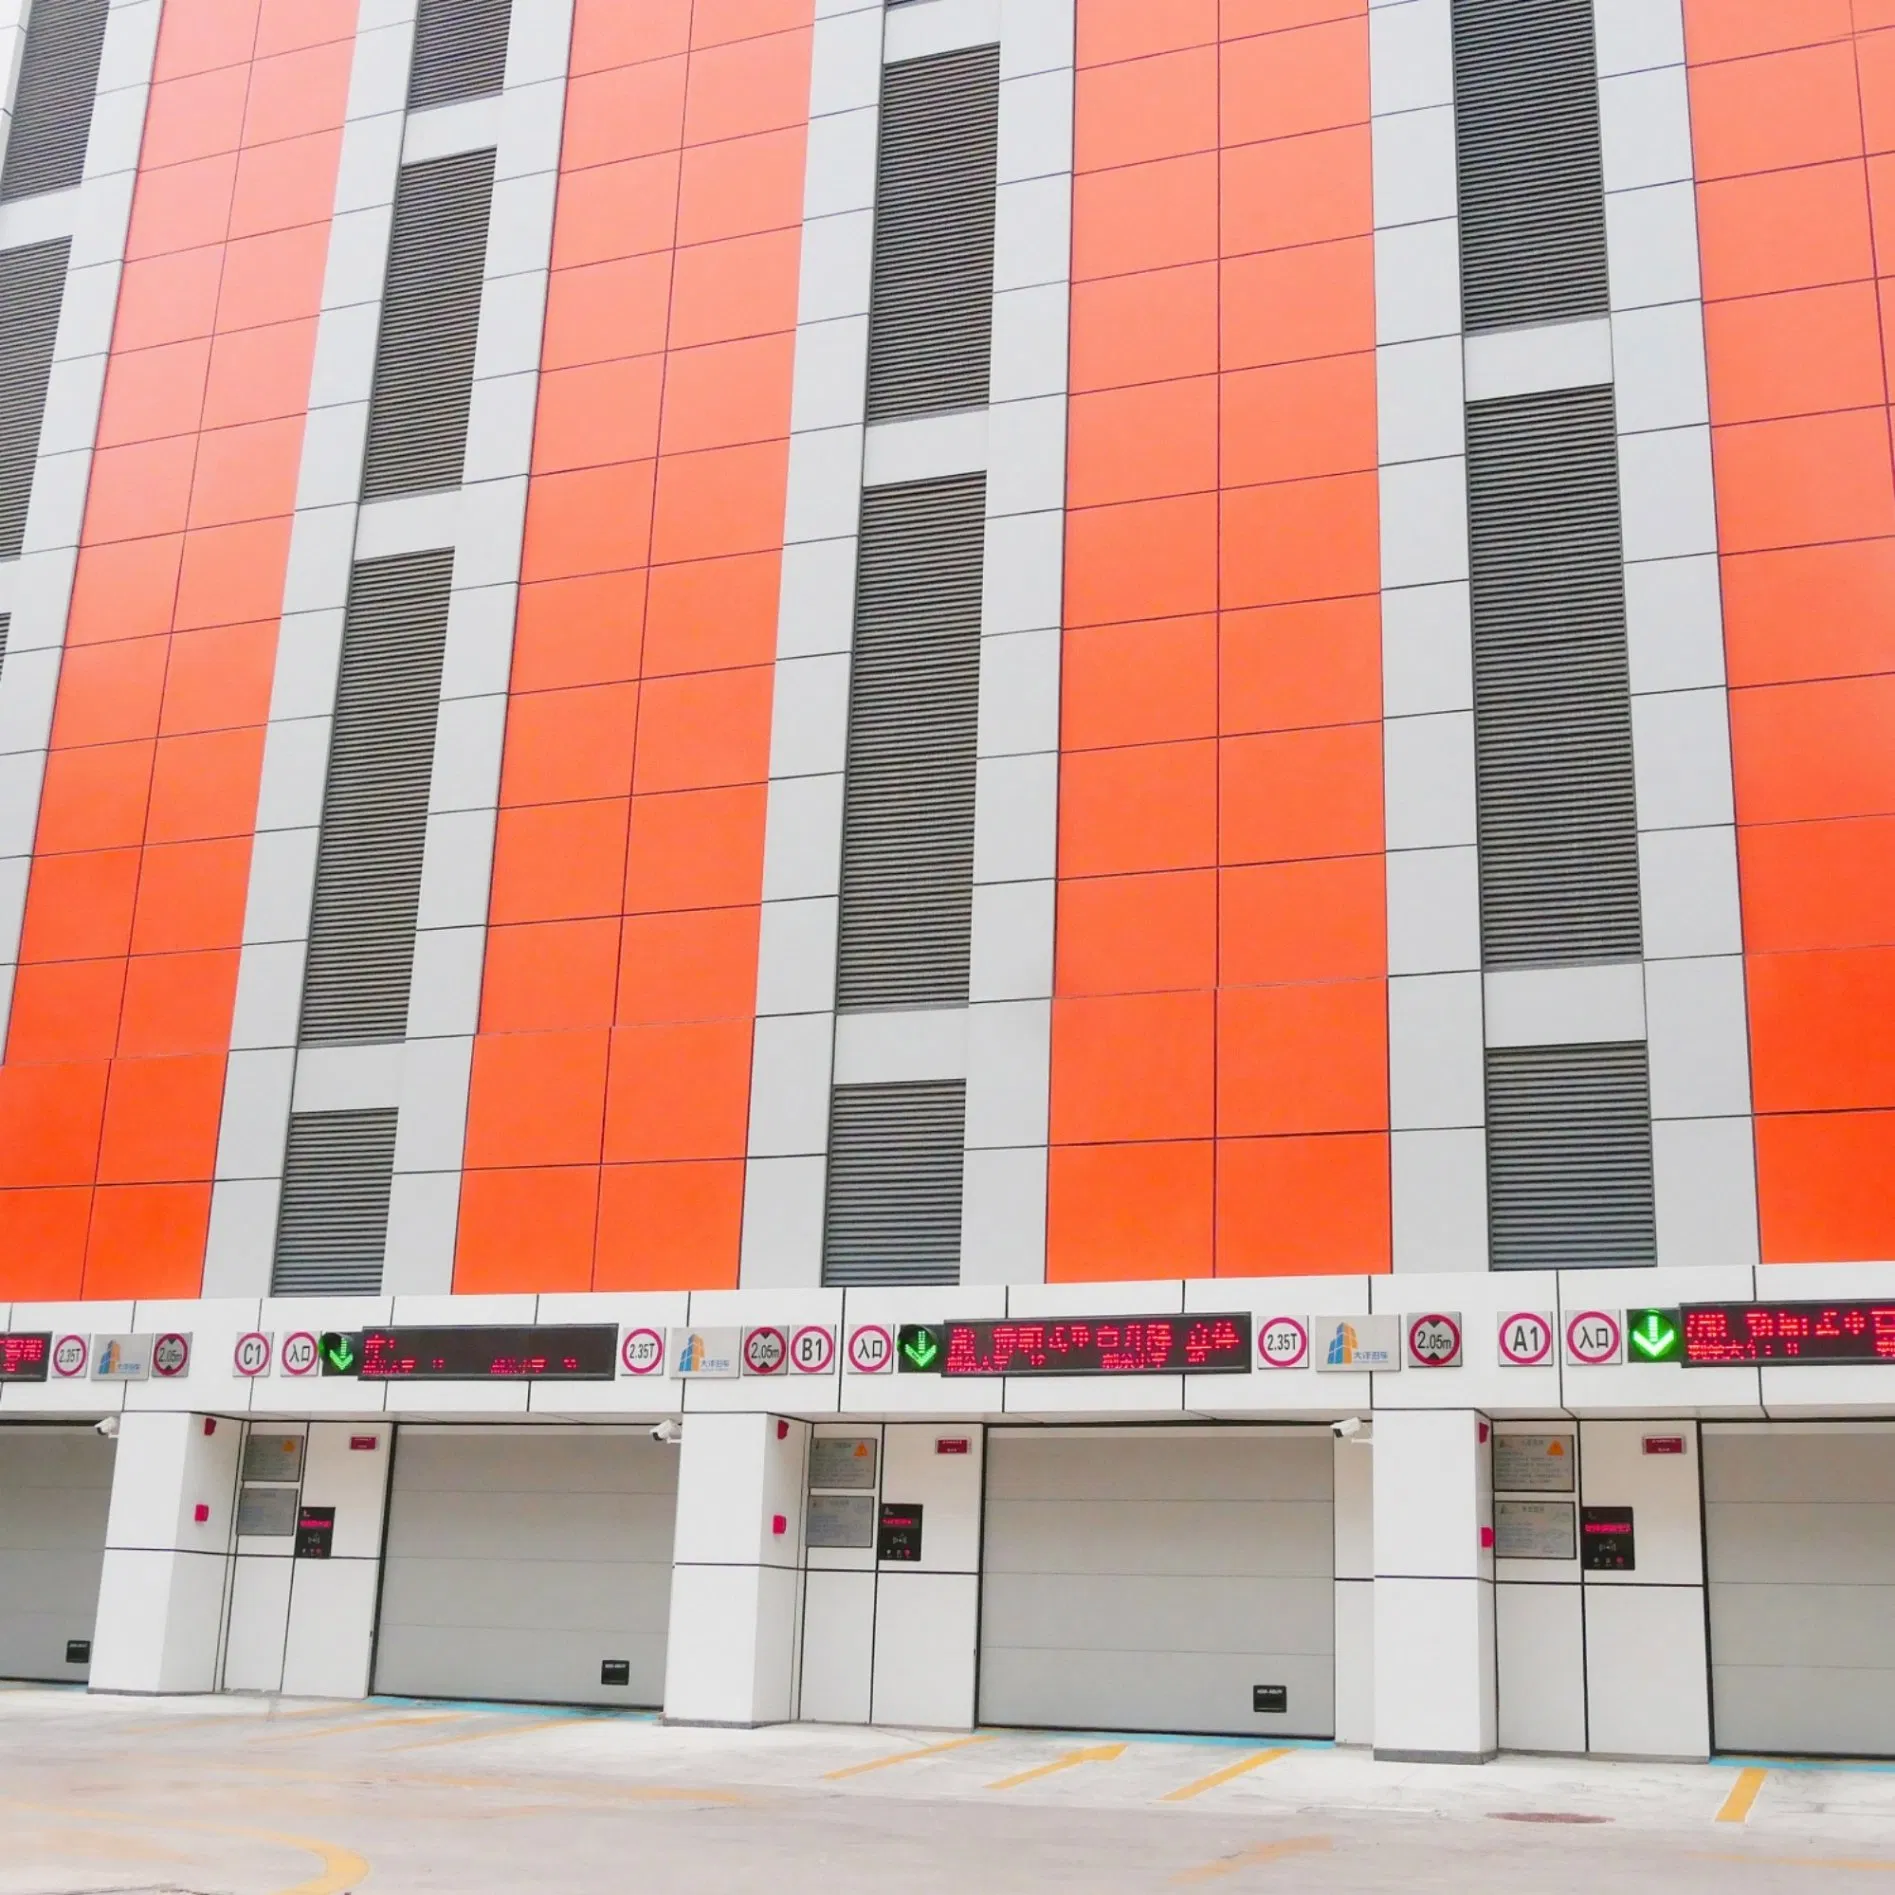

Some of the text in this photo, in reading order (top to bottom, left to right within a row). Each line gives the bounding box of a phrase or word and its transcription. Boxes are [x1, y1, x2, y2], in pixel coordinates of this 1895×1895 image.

[1267, 1333, 1297, 1351] 2.35T
[1416, 1330, 1452, 1349] 2.05m
[1512, 1325, 1538, 1352] A1
[1579, 1326, 1609, 1348] 入口
[59, 1348, 81, 1363] 2.35T
[243, 1343, 261, 1365] C1
[289, 1344, 310, 1363] 入口
[629, 1343, 656, 1359] 2.35T
[751, 1342, 779, 1359] 2.05m
[802, 1337, 822, 1361] B1
[858, 1338, 883, 1359] 入口
